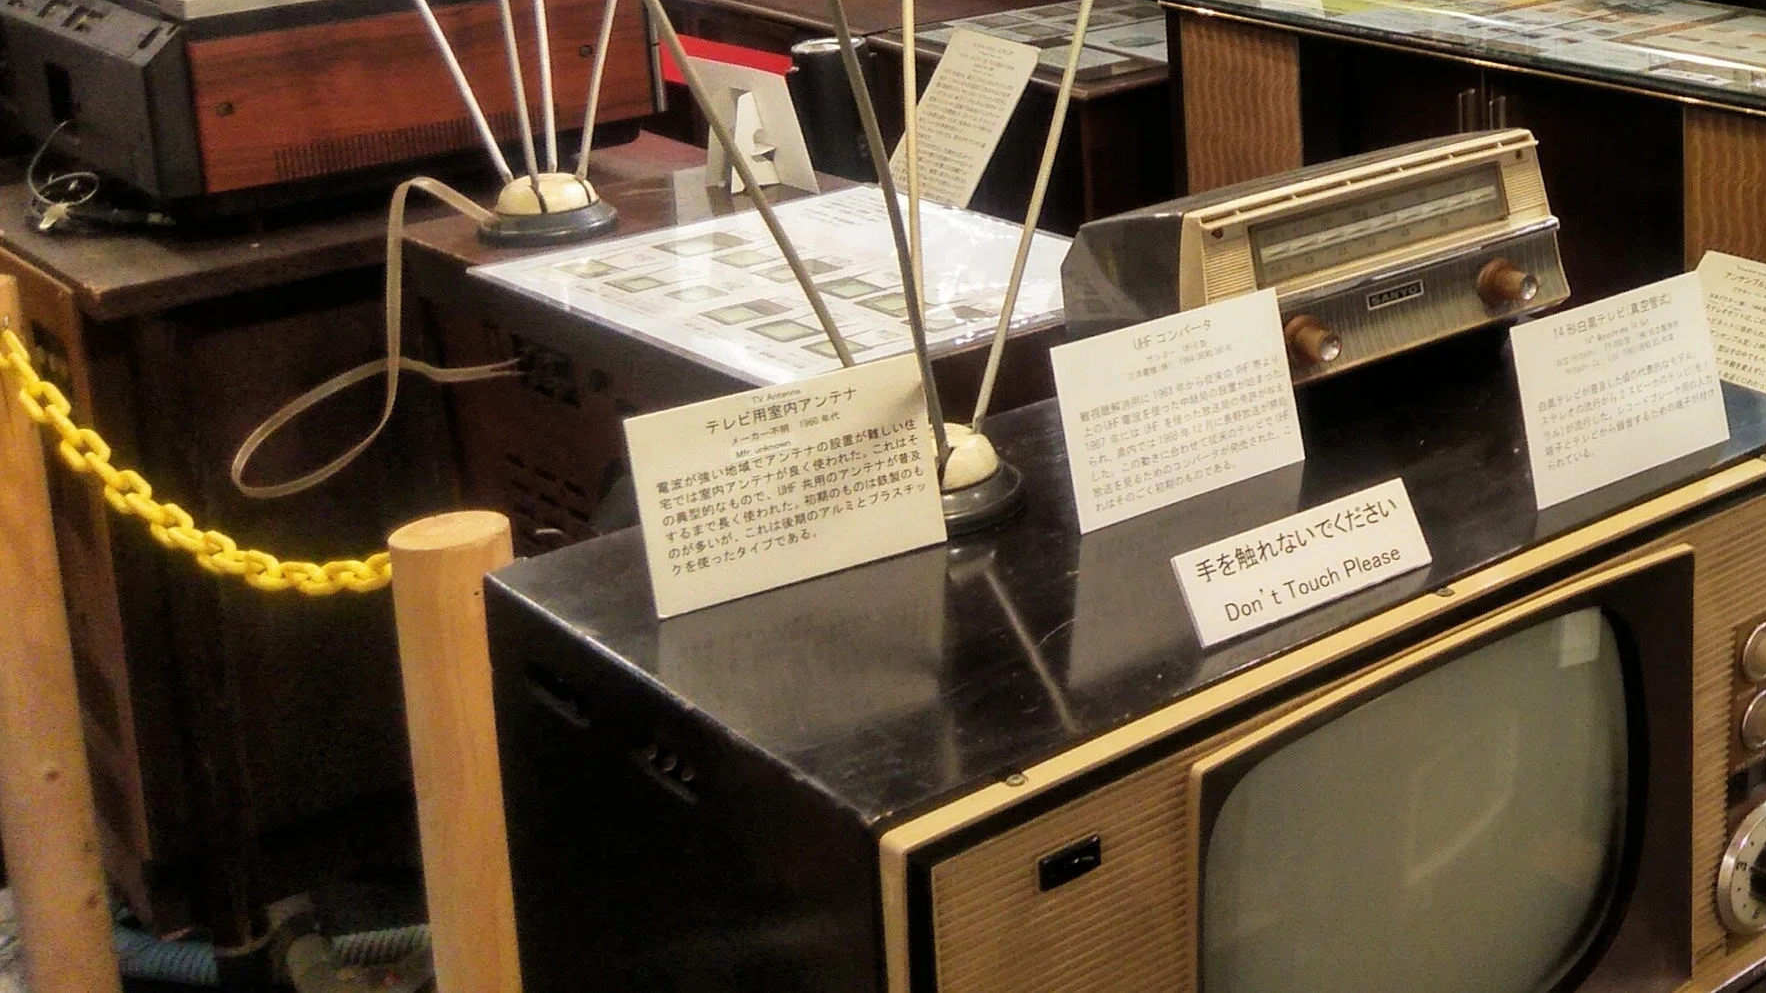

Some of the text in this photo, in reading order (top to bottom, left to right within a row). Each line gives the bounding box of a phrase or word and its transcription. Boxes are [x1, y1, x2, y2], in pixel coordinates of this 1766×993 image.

[1369, 284, 1421, 307] SANYO
[705, 386, 858, 435] テレビ用室内アンテナ
[655, 417, 916, 495] 電波が強い地域でアンテナの設置が難しい住
[657, 434, 919, 511] 宅では室内アンテナが良く使われた。これはそ
[664, 465, 924, 543] するまで長く使われた。初期のものは鉄製のも
[667, 481, 927, 561] のが多いが、これは後期のアルミとプラスチッ
[1196, 498, 1398, 583] 手を触れないでください
[670, 526, 819, 577] クを使ったタイプである。
[1224, 548, 1401, 622] Don't Touch Please
